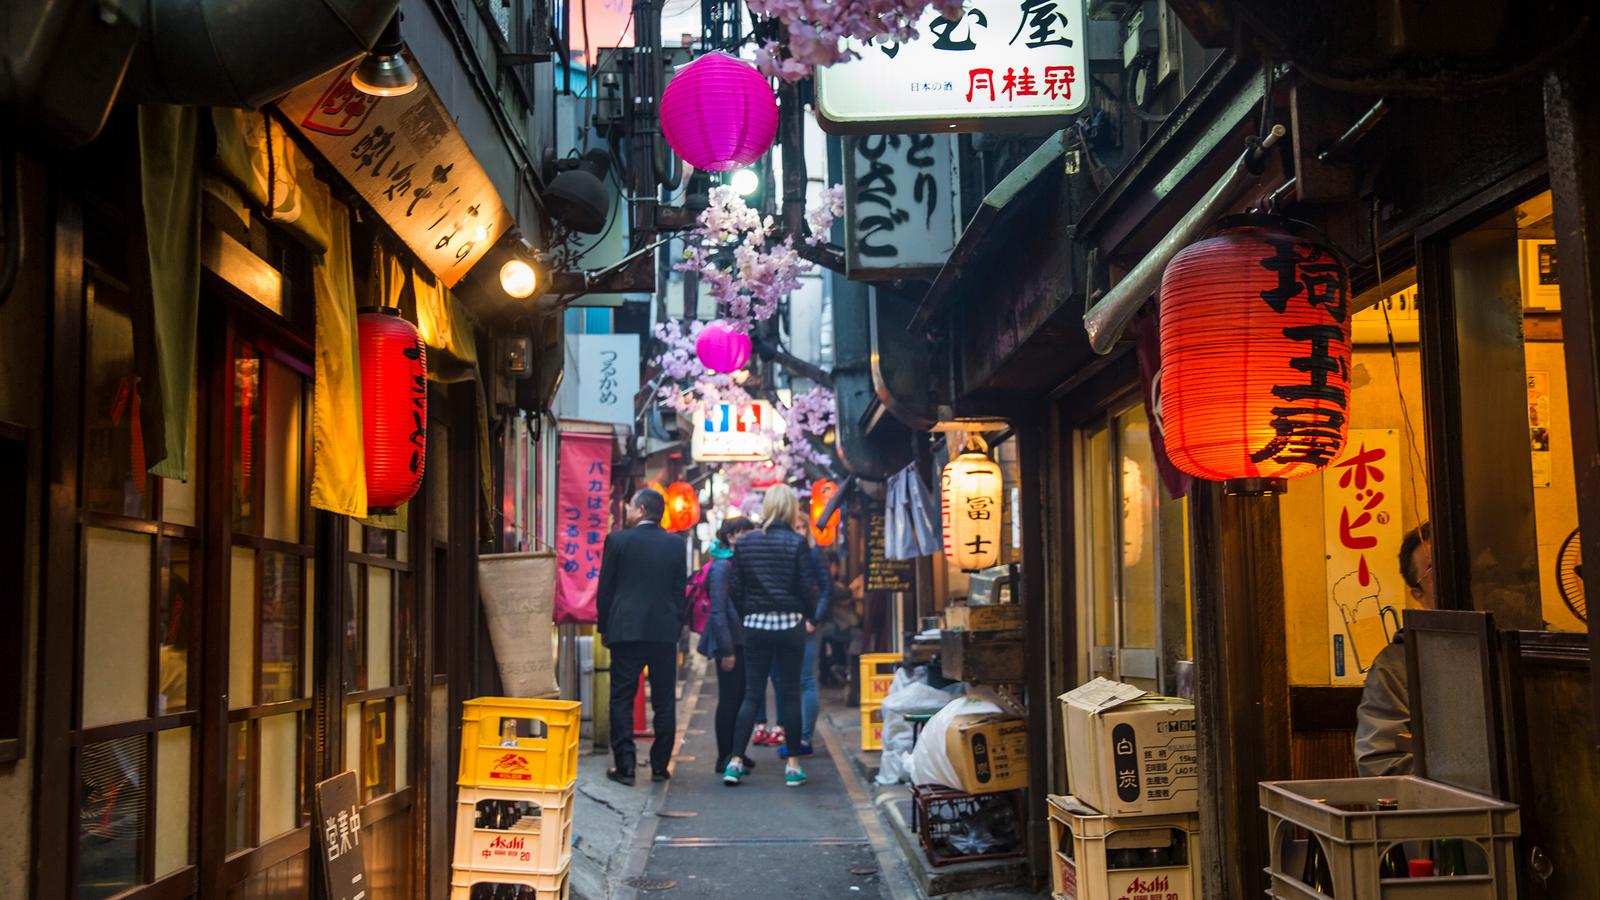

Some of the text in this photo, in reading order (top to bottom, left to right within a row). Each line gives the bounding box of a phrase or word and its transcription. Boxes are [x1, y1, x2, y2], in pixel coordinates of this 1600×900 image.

[911, 82, 953, 92] 日本の酒
[966, 65, 1075, 102] 月桂冠
[600, 350, 618, 405] つるかめ
[585, 461, 605, 580] バカはうまいよ
[1333, 440, 1386, 587] ホッピー
[563, 507, 581, 574] つるかめ
[1117, 738, 1138, 789] 白炭
[326, 805, 361, 862] 営業中
[490, 836, 525, 850] Asahi
[520, 852, 530, 861] 20
[1126, 875, 1168, 894] Asahi
